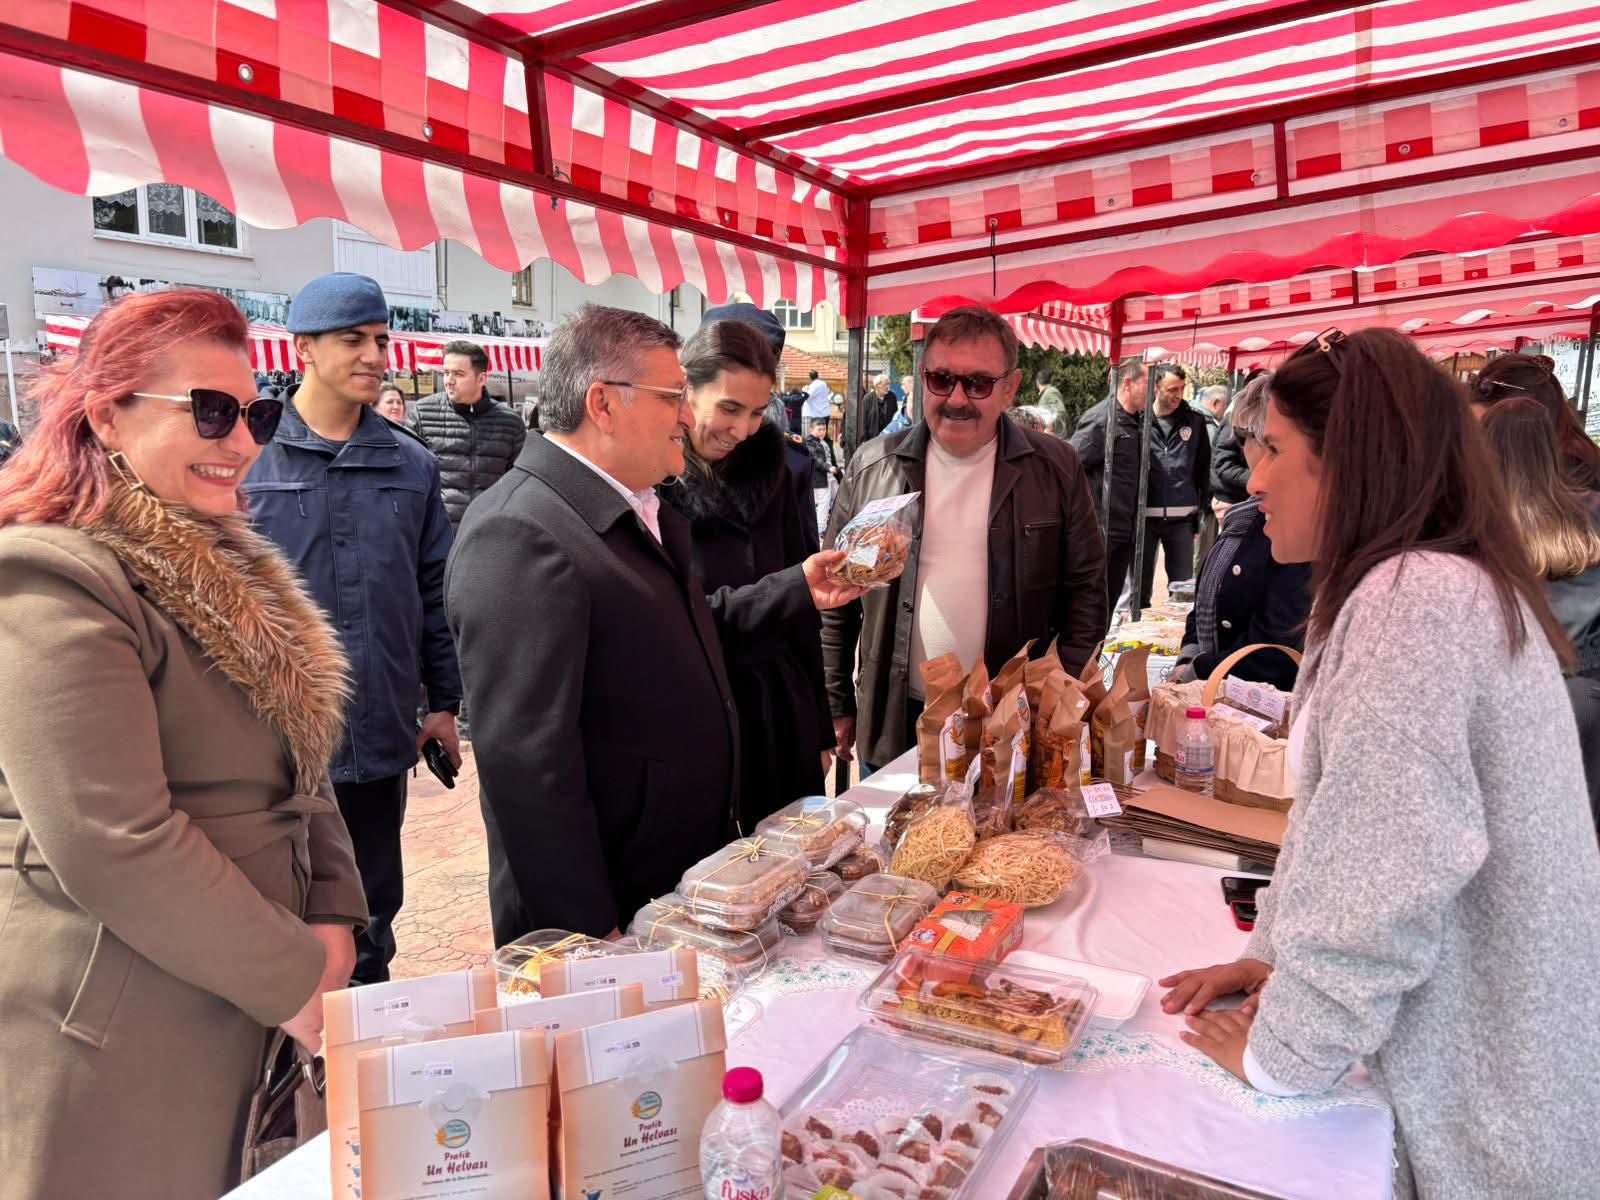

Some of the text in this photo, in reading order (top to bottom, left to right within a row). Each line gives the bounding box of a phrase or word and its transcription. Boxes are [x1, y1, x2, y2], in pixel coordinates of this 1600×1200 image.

[639, 1120, 662, 1132] Pratik
[623, 1136, 639, 1148] Un
[641, 1126, 678, 1144] Helvası
[444, 1150, 471, 1161] Pratik
[426, 1160, 489, 1177] Un Helvası
